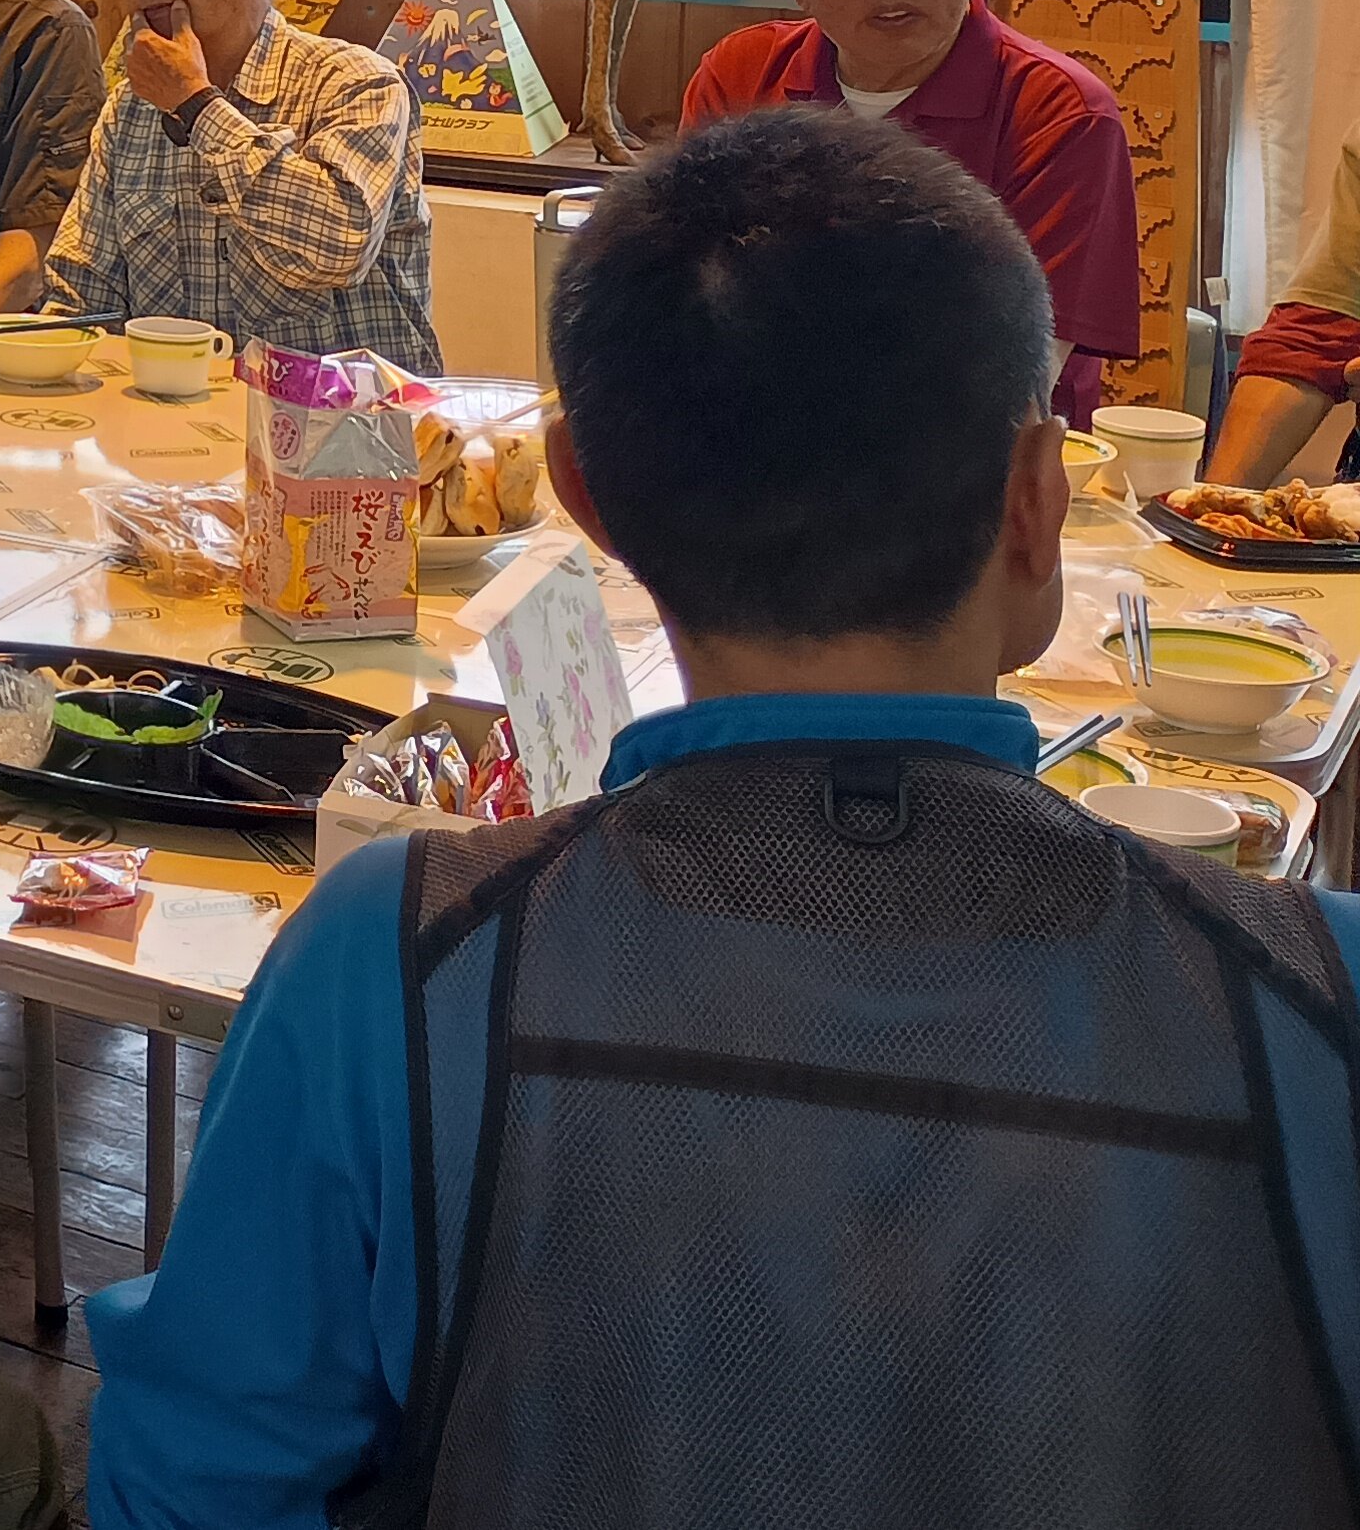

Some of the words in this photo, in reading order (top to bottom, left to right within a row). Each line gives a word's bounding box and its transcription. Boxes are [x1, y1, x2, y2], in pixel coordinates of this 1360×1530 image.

[351, 488, 385, 620] 桜えびせんべい
[168, 896, 255, 913] Coleman
